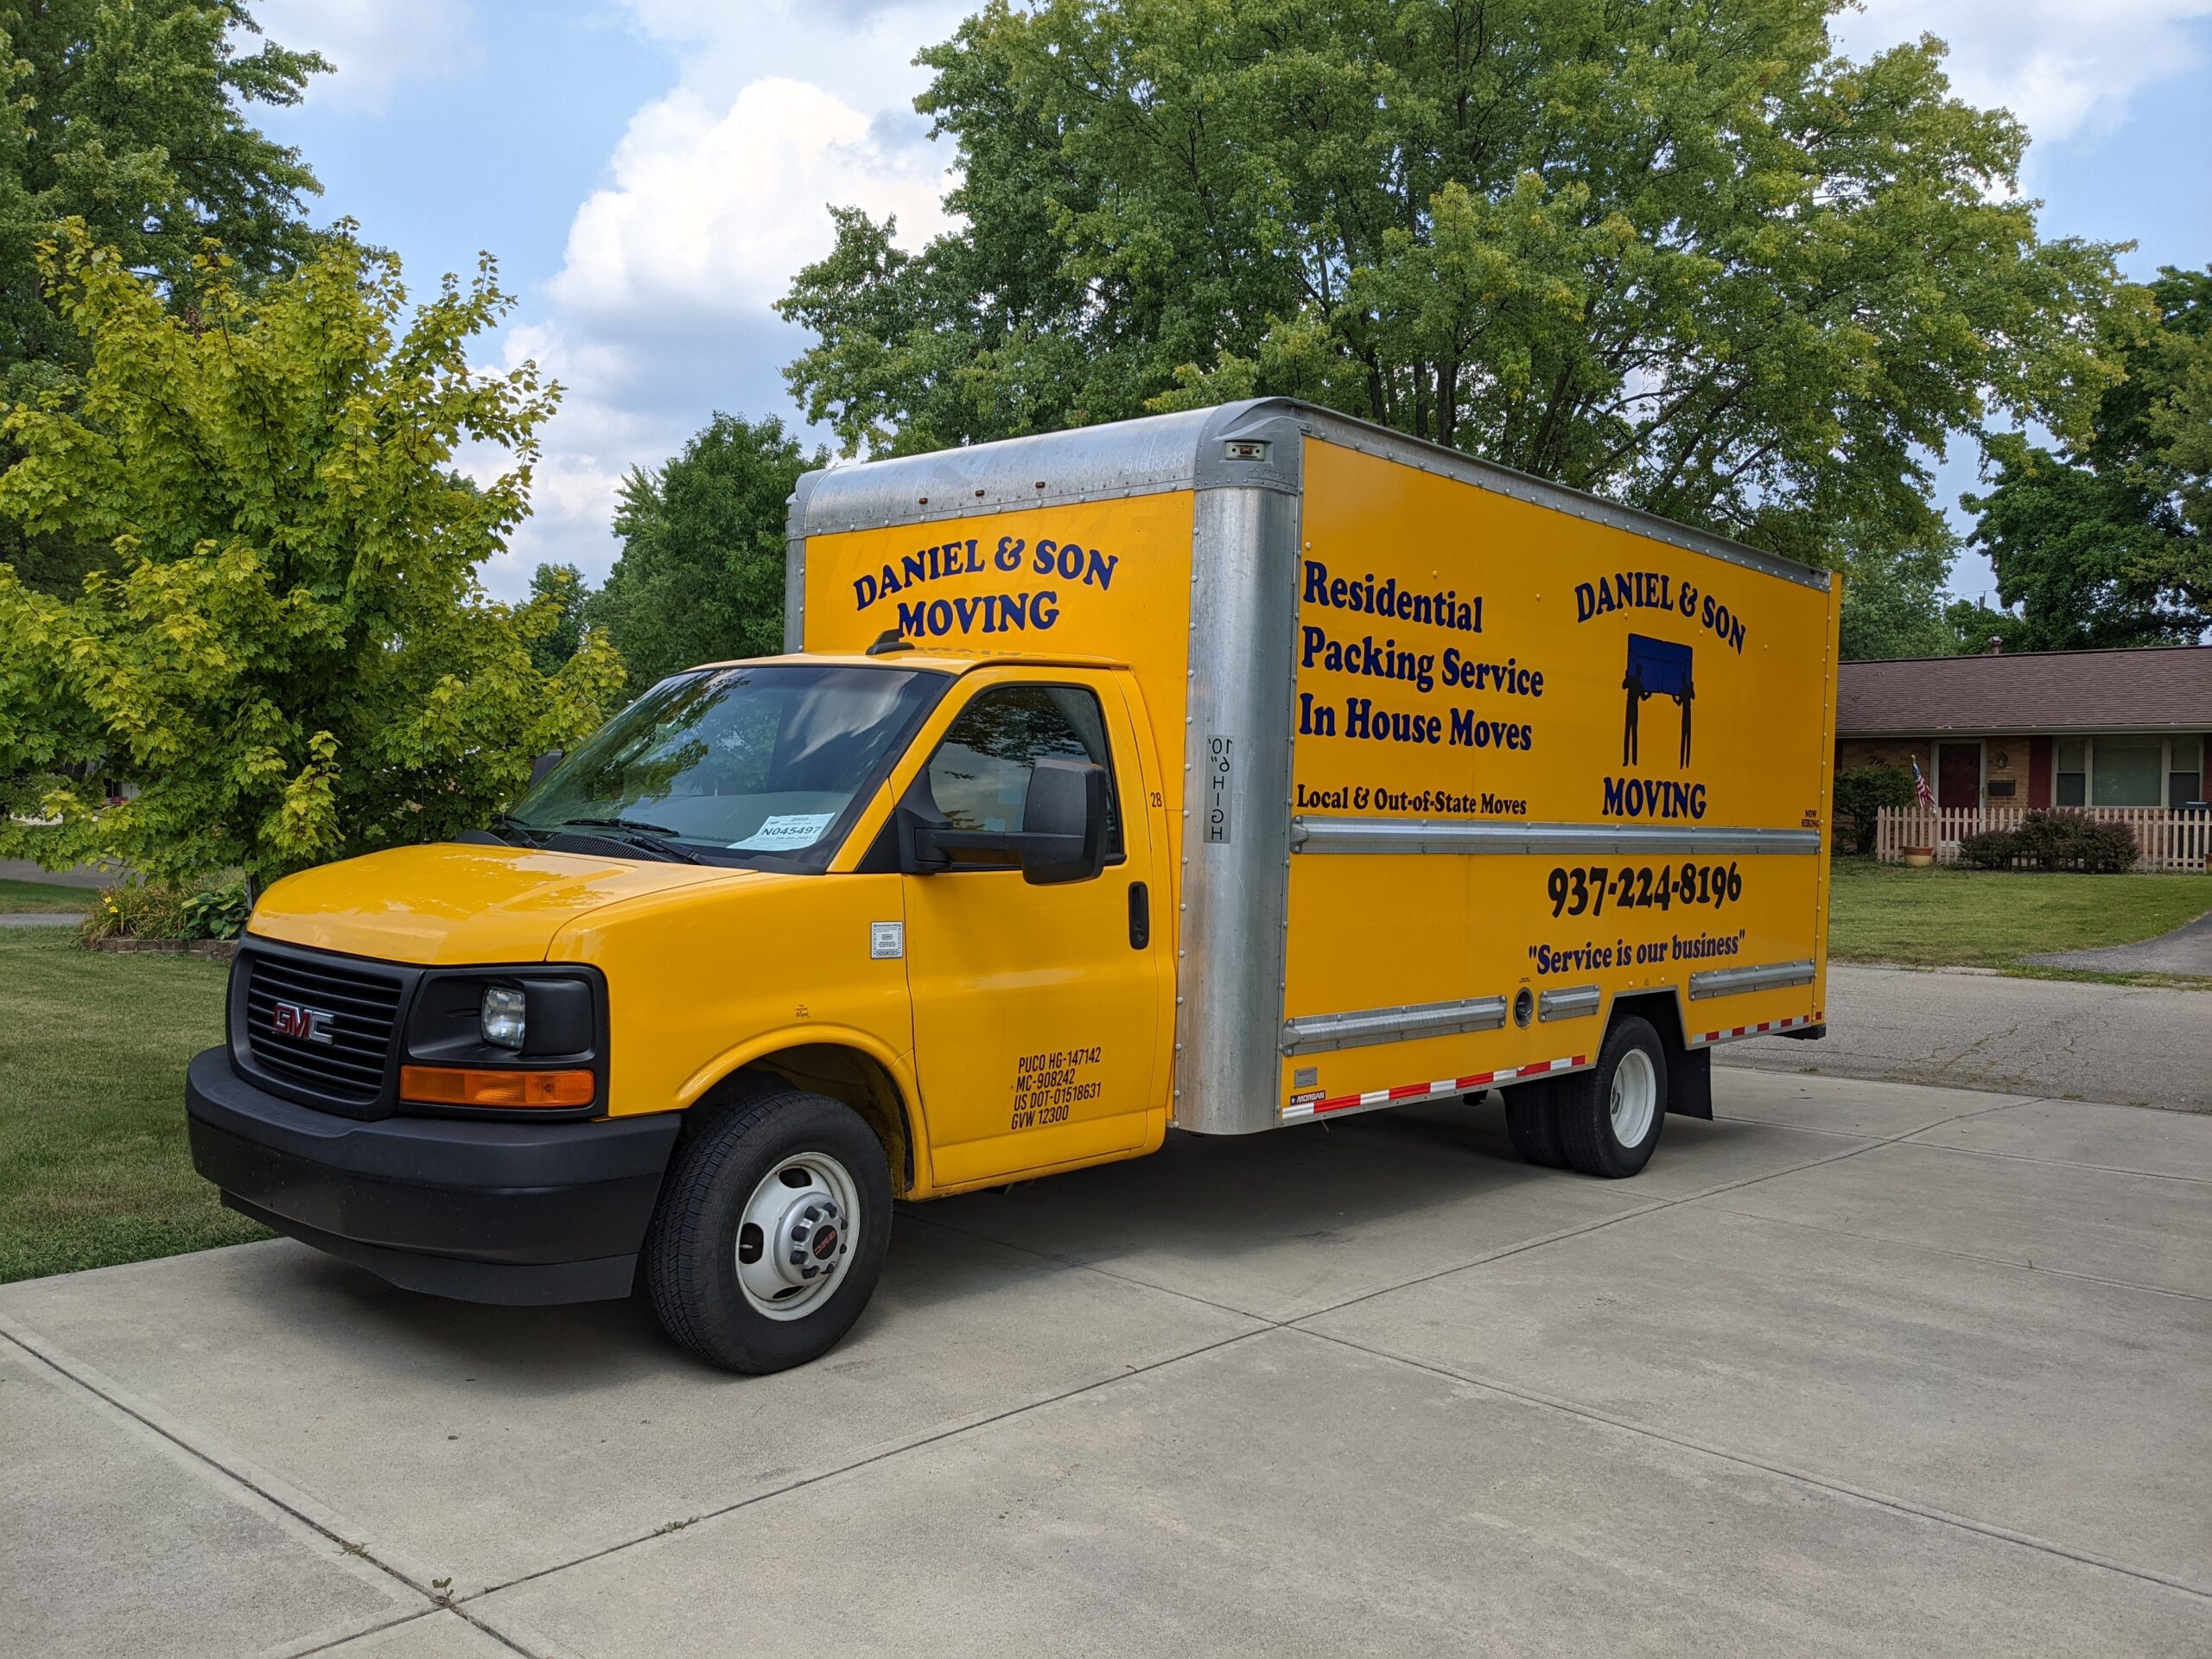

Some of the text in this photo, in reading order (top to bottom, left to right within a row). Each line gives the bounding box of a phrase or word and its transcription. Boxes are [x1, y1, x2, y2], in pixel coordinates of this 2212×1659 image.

[853, 536, 1119, 611] DANIEL & SON
[897, 591, 1060, 639] MOVING
[1302, 560, 1483, 633] Residential
[1573, 571, 1746, 656] DANIEL & SON
[1301, 626, 1544, 697] Packing Service
[1299, 693, 1532, 751] In House Moves
[1150, 792, 1162, 807] 28
[1297, 784, 1527, 815] Local & Out-of-State Moves
[1601, 777, 1707, 819] MOVING
[760, 826, 823, 836] N045497
[1548, 861, 1742, 918] 937-224-8196
[1528, 928, 1745, 975] "Service is our business"
[273, 1002, 334, 1045] GMC
[1016, 1068, 1076, 1093] MC-908242
[1018, 1046, 1102, 1074] PUCO HG-147142
[1011, 1104, 1070, 1130] GVW 12300
[1014, 1082, 1102, 1112] US DOT-01518631
[1296, 1091, 1325, 1103] MORGAN
